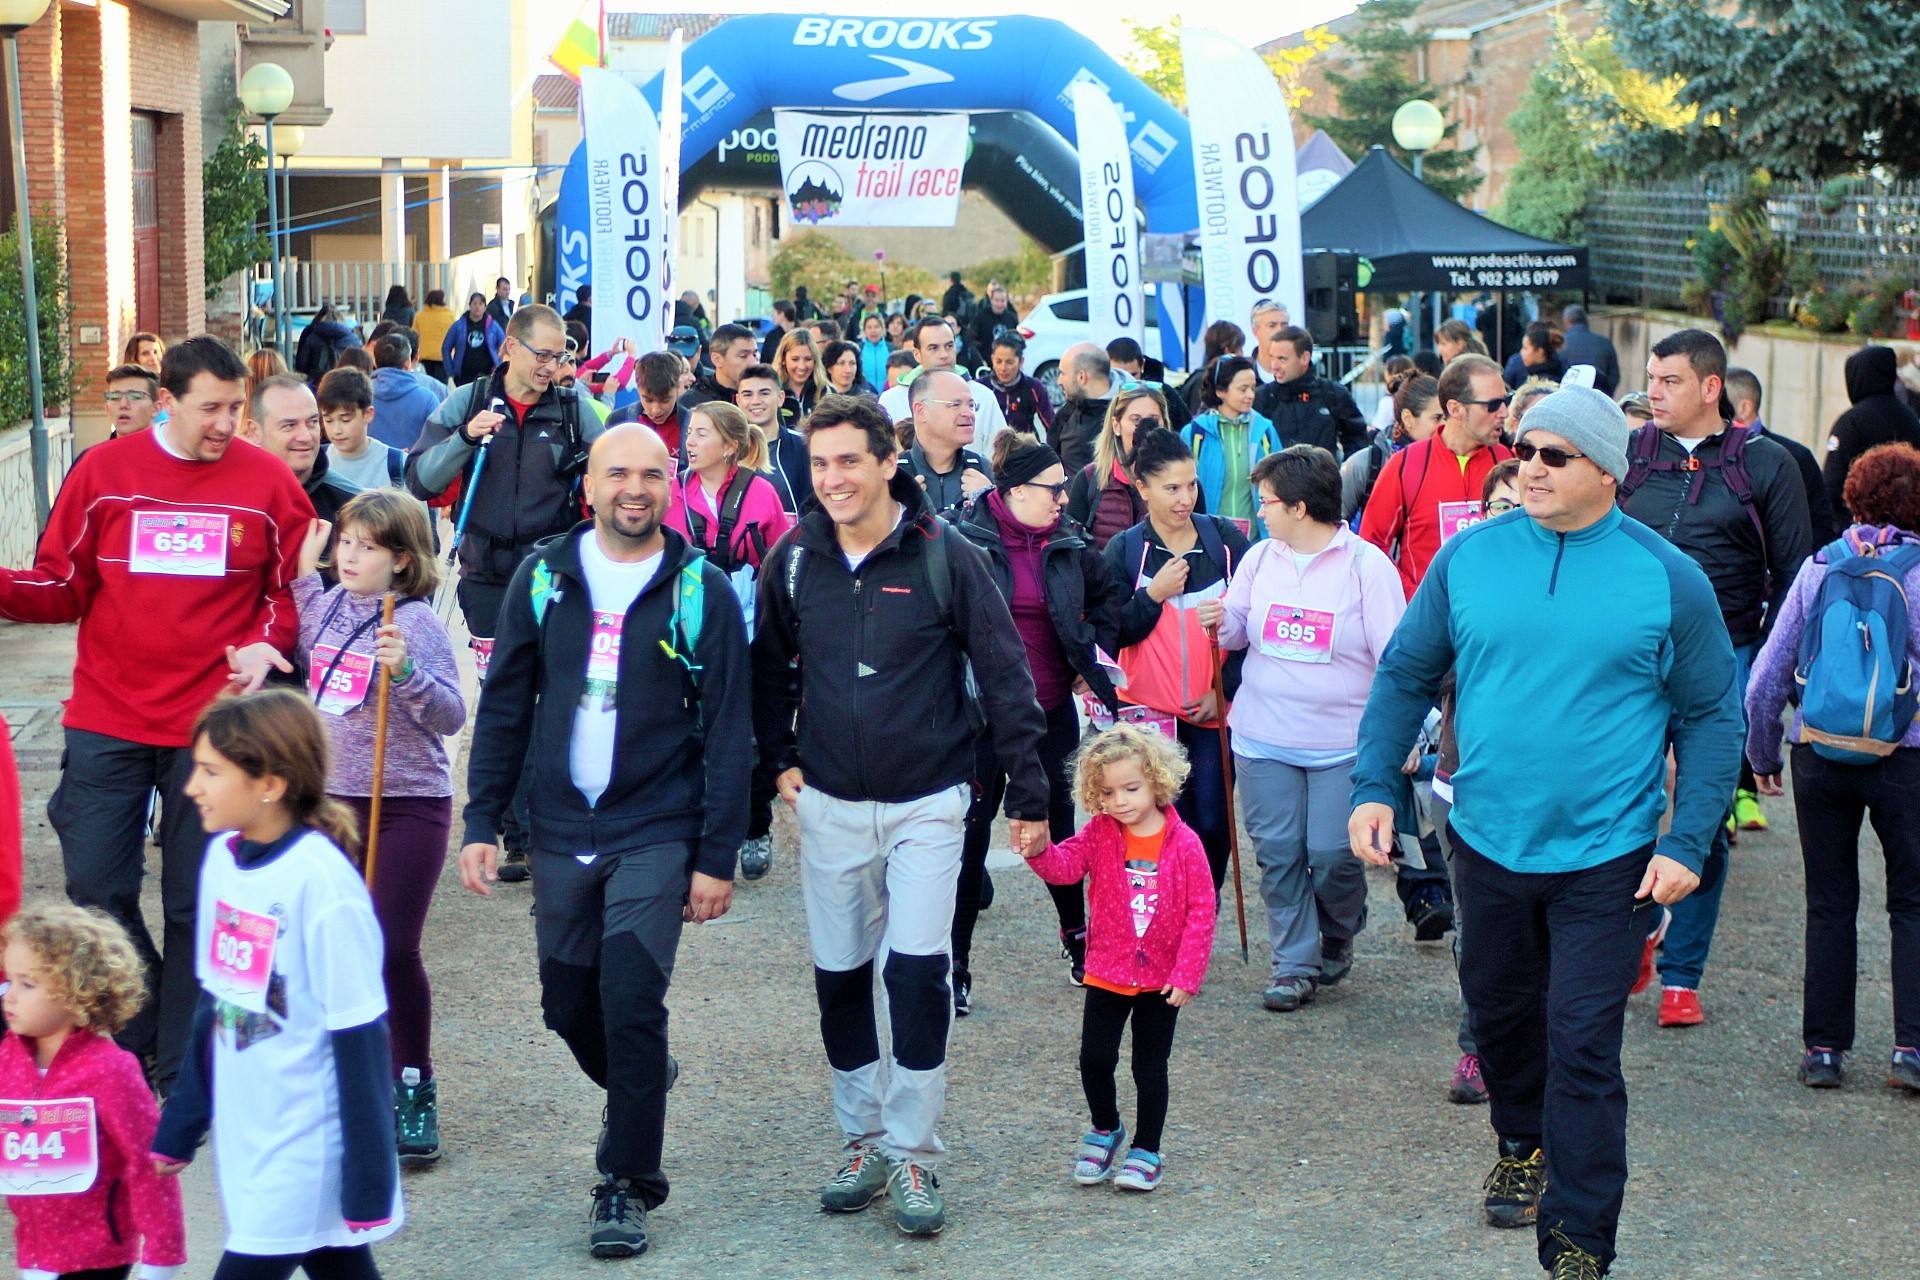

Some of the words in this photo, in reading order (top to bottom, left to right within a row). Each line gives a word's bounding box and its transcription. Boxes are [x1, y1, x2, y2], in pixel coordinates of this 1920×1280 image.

[792, 17, 998, 50] BROOKS
[801, 115, 927, 160] medrano
[856, 162, 904, 198] trail
[908, 168, 959, 197] race
[1432, 252, 1577, 271] www.podoactiva.com
[1448, 270, 1475, 287] Tel.
[1477, 270, 1504, 287] 902
[1505, 270, 1532, 287] 365
[1532, 269, 1560, 287] 099
[154, 531, 206, 553] 654
[1276, 621, 1316, 644] 695
[217, 931, 253, 971] 603
[4, 1131, 66, 1161] 644
